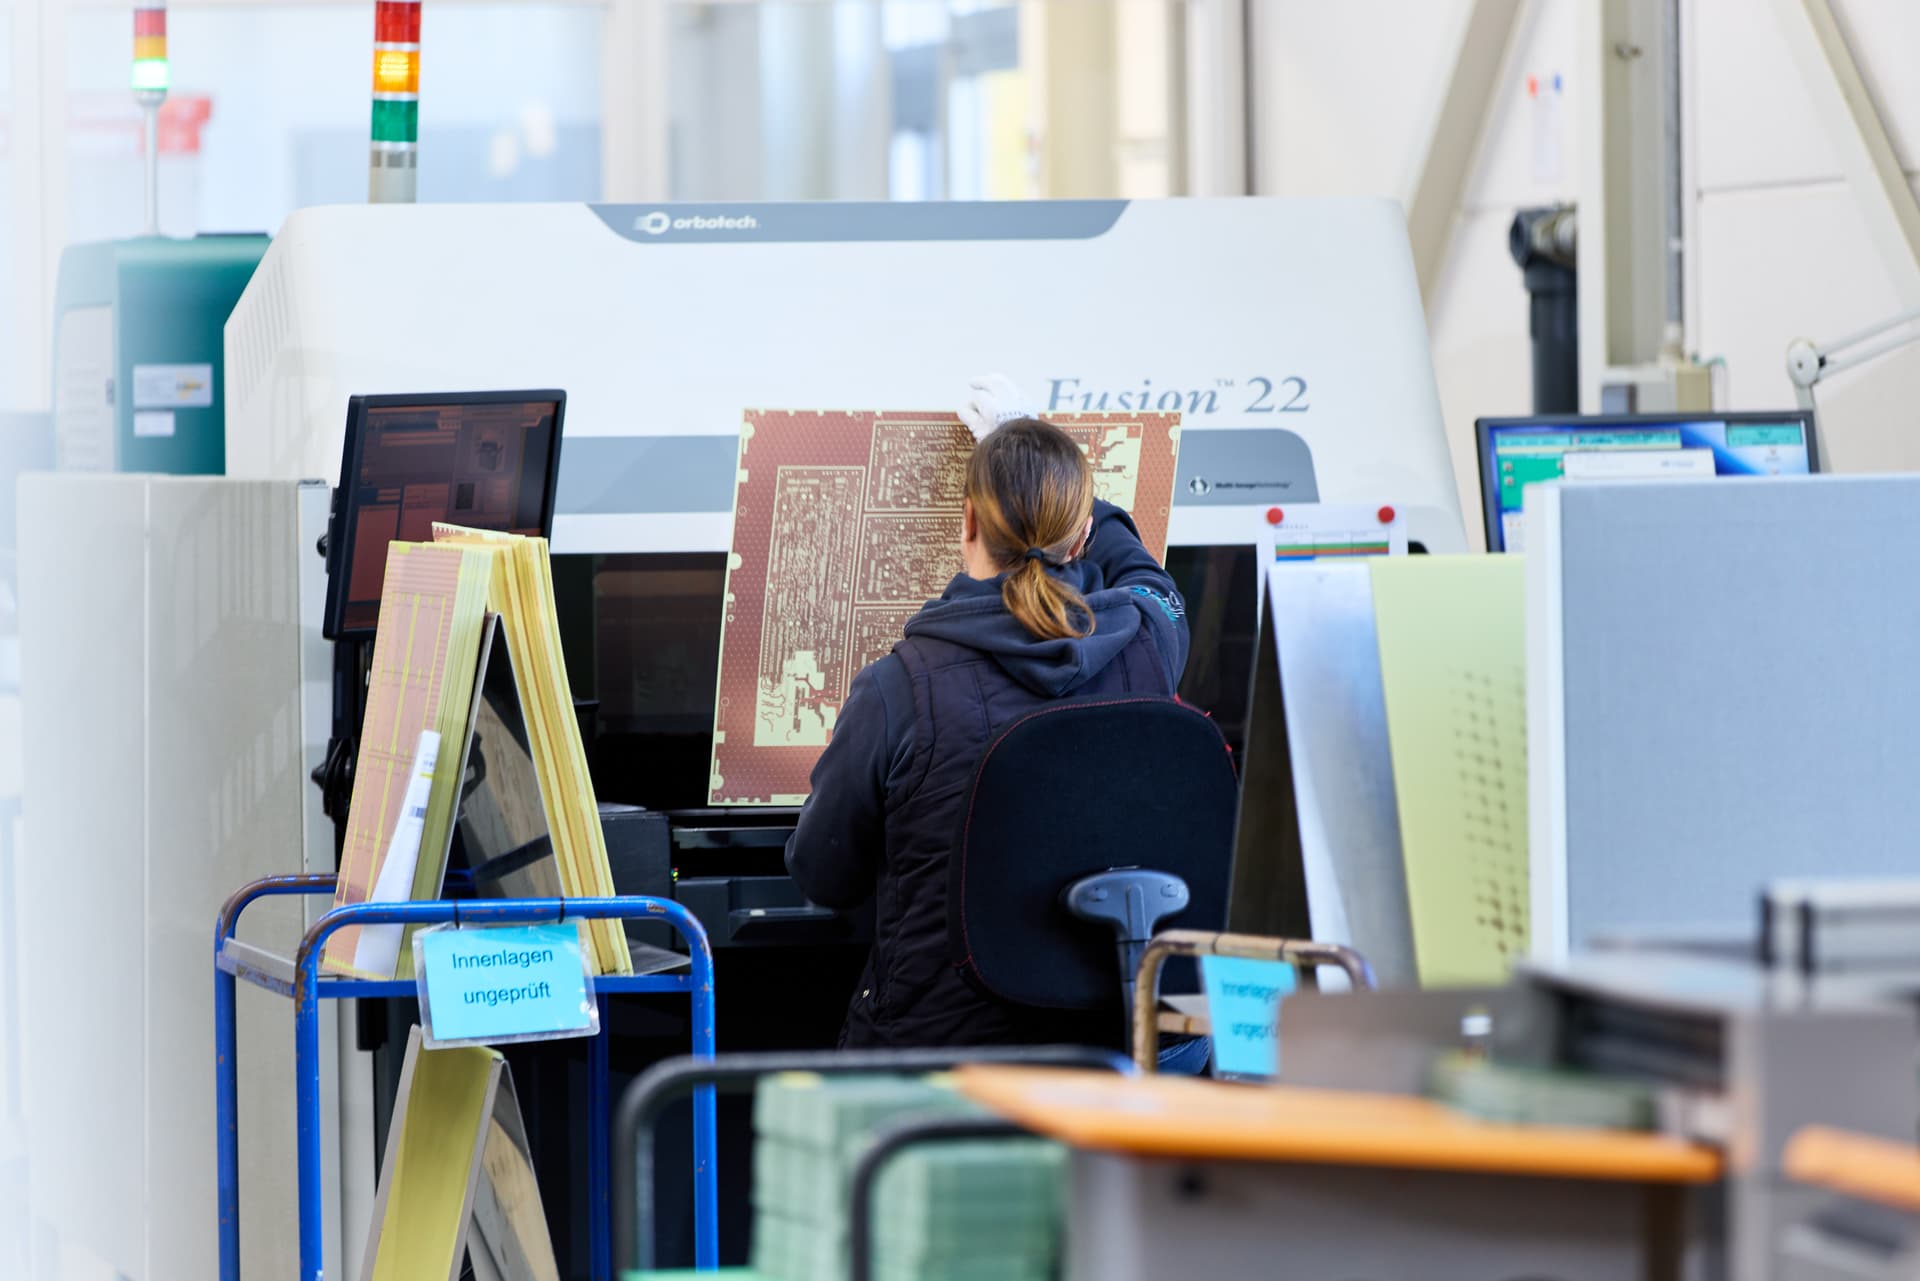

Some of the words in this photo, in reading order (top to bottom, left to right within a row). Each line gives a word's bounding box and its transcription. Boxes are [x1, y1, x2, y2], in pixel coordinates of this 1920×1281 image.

[1244, 375, 1311, 414] 22
[452, 949, 553, 969] Innenlagen
[464, 982, 552, 1006] ungeprüft
